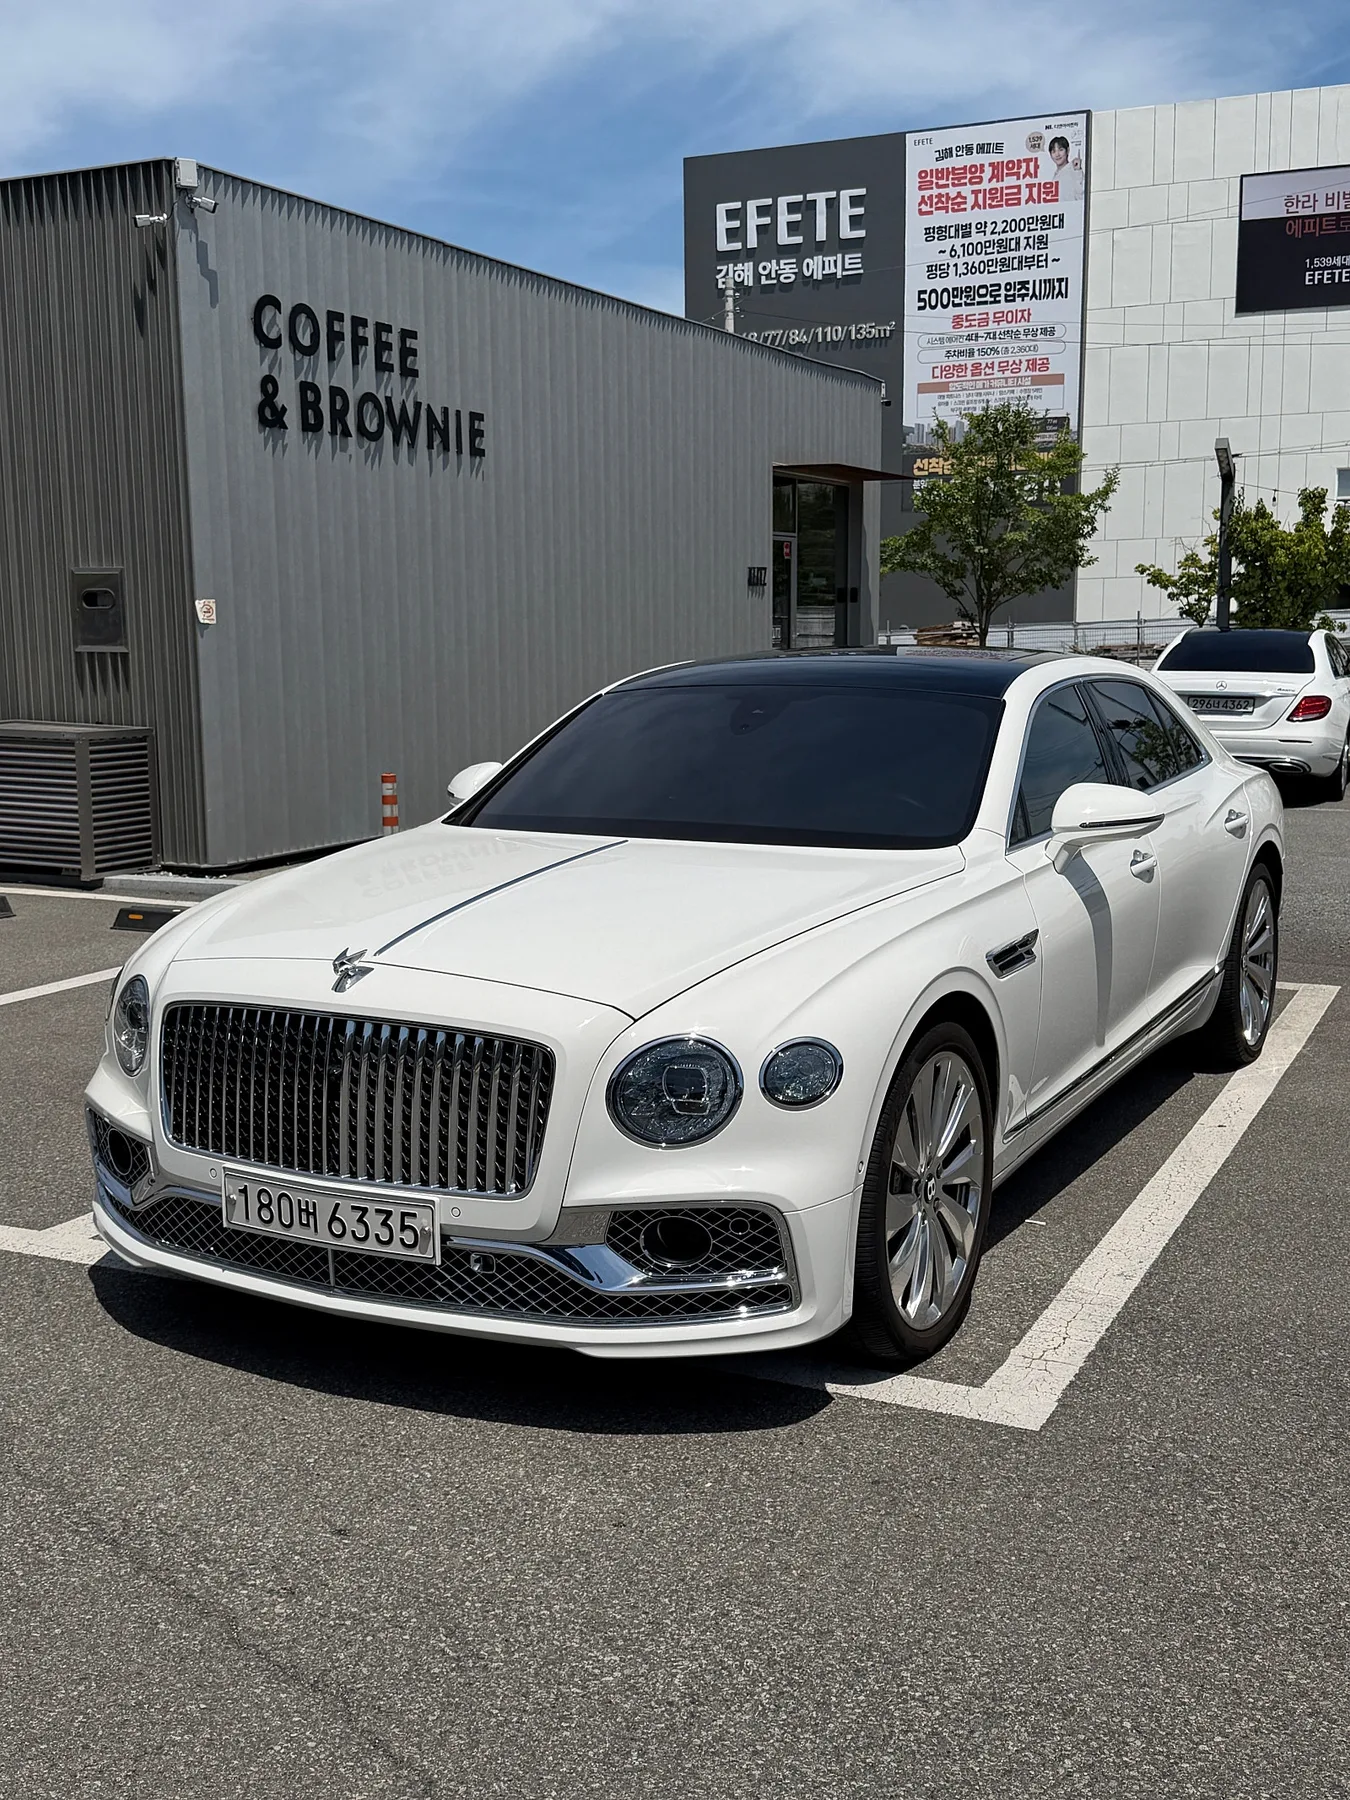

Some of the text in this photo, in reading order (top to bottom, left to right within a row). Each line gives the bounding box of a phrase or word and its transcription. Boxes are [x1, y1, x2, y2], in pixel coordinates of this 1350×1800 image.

[913, 137, 933, 146] EFETE
[935, 142, 1004, 162] 김해 안동 에피트
[917, 157, 1040, 191] 일반분양 계약자
[917, 180, 1059, 216] 선착순 지원금 지원
[1283, 193, 1318, 215] 한라
[716, 187, 867, 252] EFETE
[924, 212, 1065, 242] 평형대별 약 2,200만원대
[949, 236, 1021, 259] 6,100만원대
[1023, 233, 1049, 251] 지원
[716, 253, 864, 289] 김해 안동 에피트
[926, 261, 950, 280] 평당
[953, 253, 1049, 279] 1,360만원대부터
[1305, 268, 1350, 285] EFETE
[917, 282, 1002, 311] 500만원으로
[951, 308, 1031, 330] 중도금 무이자
[253, 294, 419, 378] COFFEE
[998, 329, 1022, 340] 선착순
[1022, 328, 1039, 339] 무상
[1039, 326, 1056, 337] 제공
[944, 348, 975, 360] 주차비율
[977, 346, 1000, 357] 150%
[932, 357, 1051, 380] 다양한 옵션 무상 제공
[258, 374, 486, 458] & BROWNIE
[1222, 700, 1250, 710] 4362
[238, 1184, 419, 1249] 180버 6335
